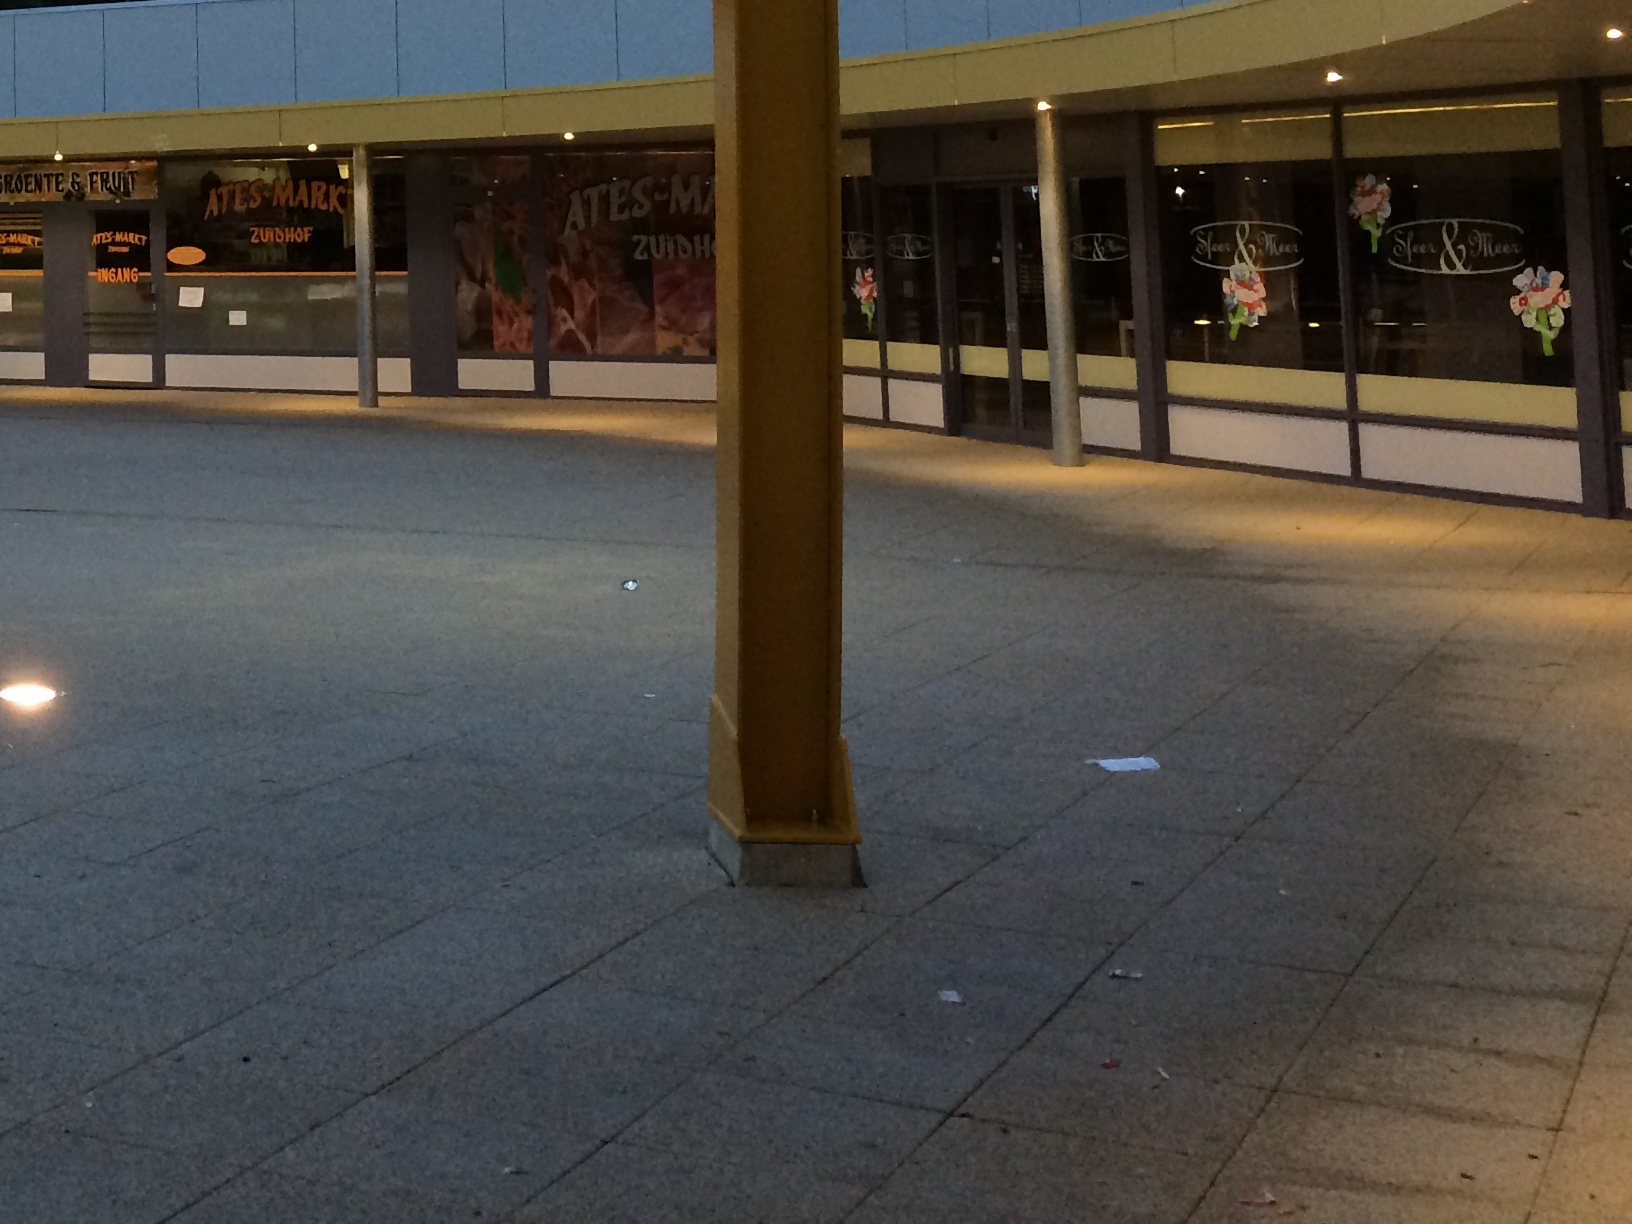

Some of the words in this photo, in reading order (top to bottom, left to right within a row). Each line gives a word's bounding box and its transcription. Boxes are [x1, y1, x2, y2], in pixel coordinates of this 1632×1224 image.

[70, 171, 81, 193] &
[87, 170, 139, 195] FRUIT
[91, 231, 147, 246] ATES-MARKT
[249, 226, 314, 244] ZUIDHOF
[1195, 230, 1231, 260] Sfeer
[1392, 230, 1437, 264] Sfeer
[1439, 220, 1471, 273] &
[1468, 229, 1522, 258] Meer
[98, 267, 139, 284] INGANG
